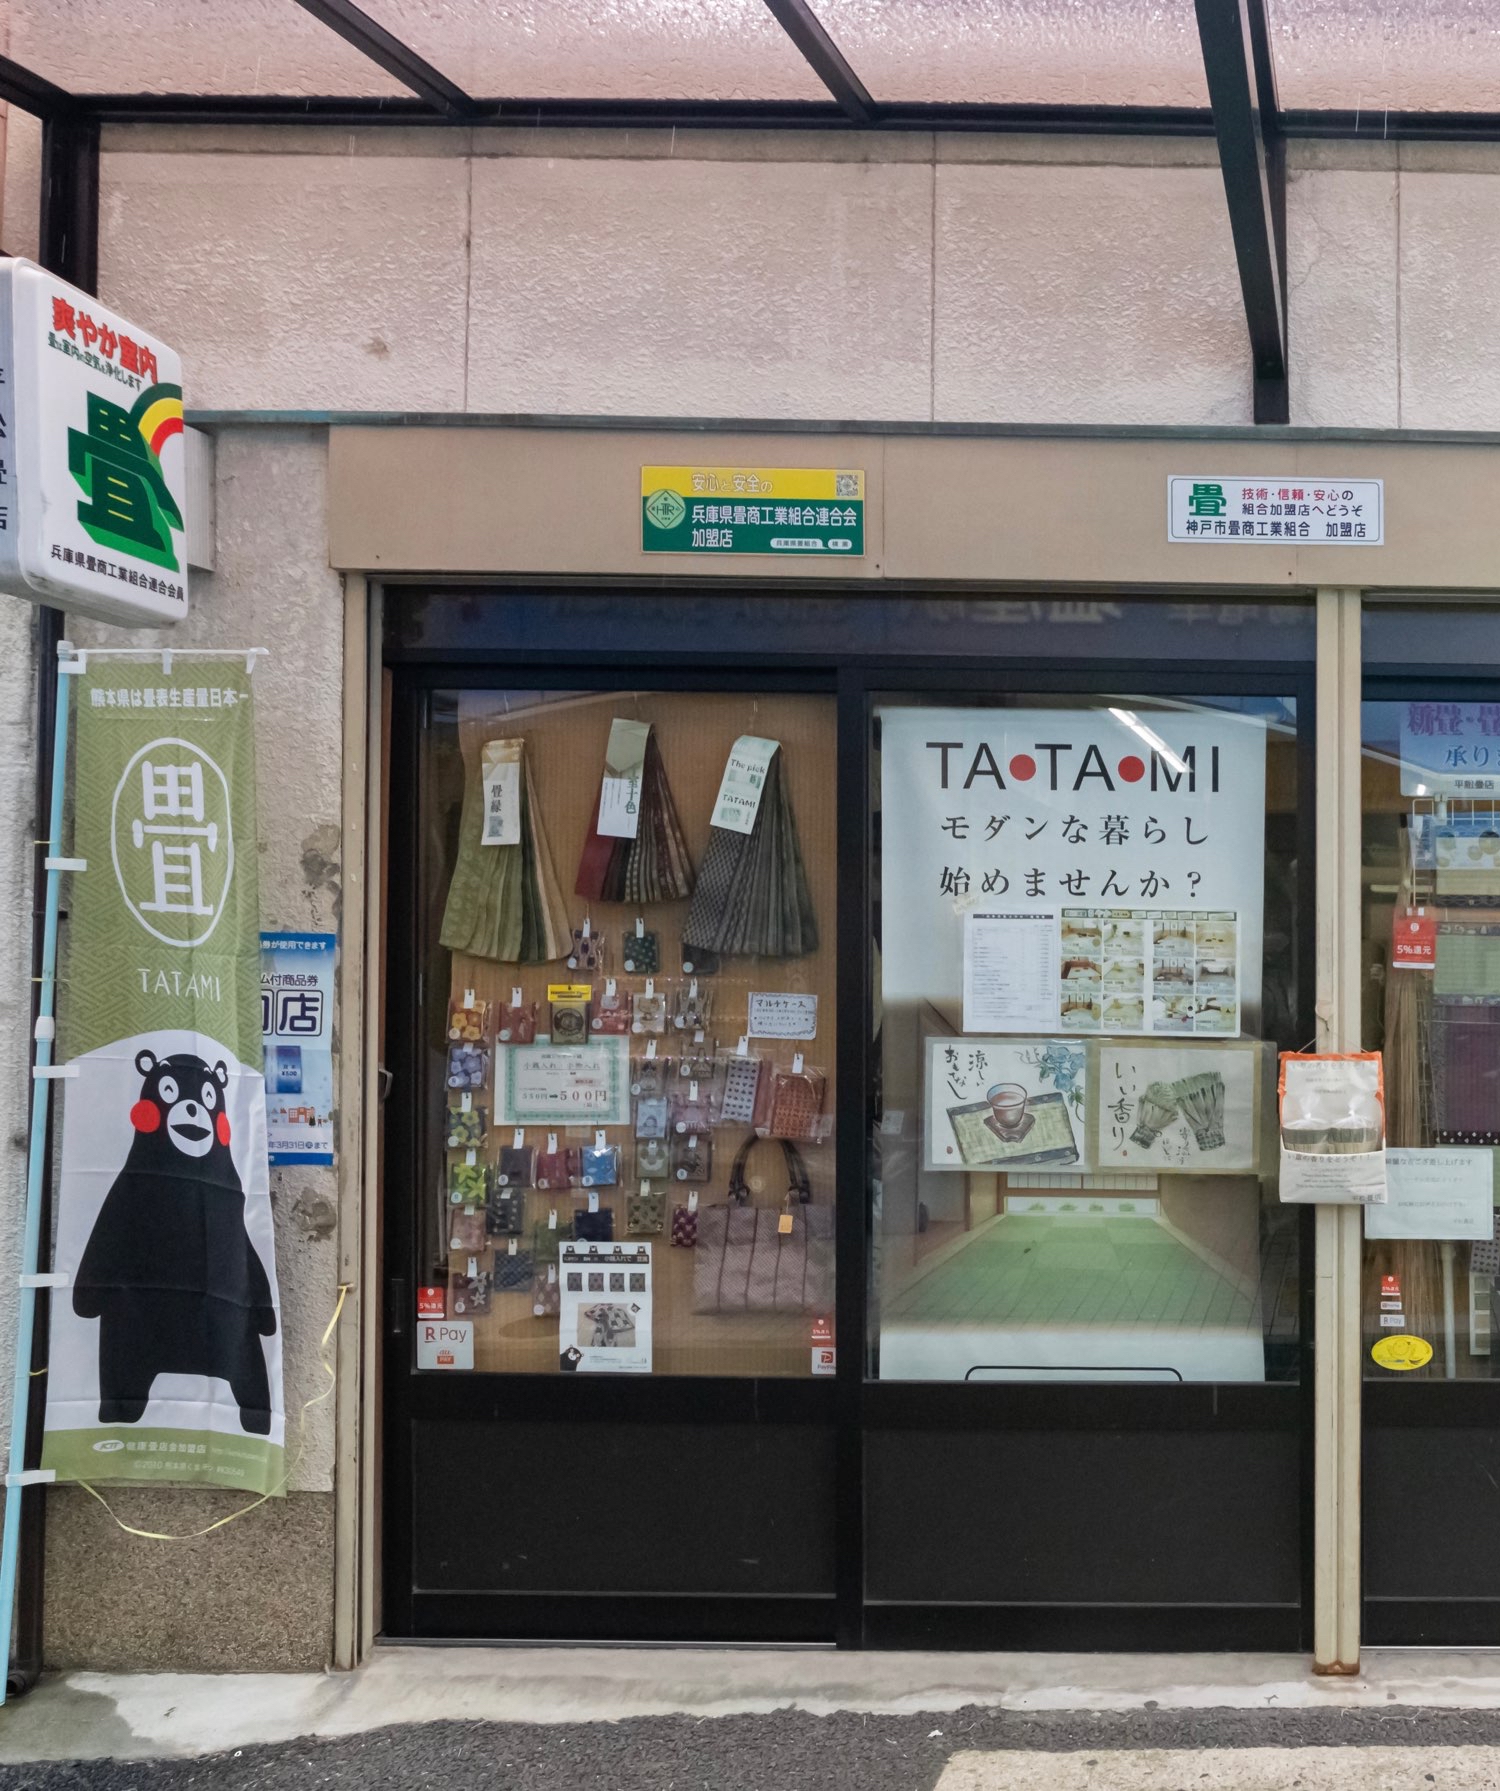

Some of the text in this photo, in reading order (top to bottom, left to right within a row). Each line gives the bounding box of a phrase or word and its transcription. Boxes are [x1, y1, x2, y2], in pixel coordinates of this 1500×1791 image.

[51, 296, 158, 385] 爽やか室内
[692, 473, 773, 493] 安心と安全の
[1188, 483, 1227, 517] 畳
[1242, 503, 1363, 517] 組合加盟店へどうぞ
[691, 505, 857, 527] 兵庫県畳商工業組合連合会
[691, 528, 733, 548] 加盟店
[1186, 519, 1366, 538] 神戸市畳商工業組合 加盟店
[132, 761, 218, 916] 畳
[940, 814, 1209, 846] モダンな暮らし
[939, 866, 1203, 898] 始めませんか？
[258, 940, 327, 950] 券が使用できます
[137, 968, 222, 1002] TATAMI
[440, 1327, 467, 1343] Pay
